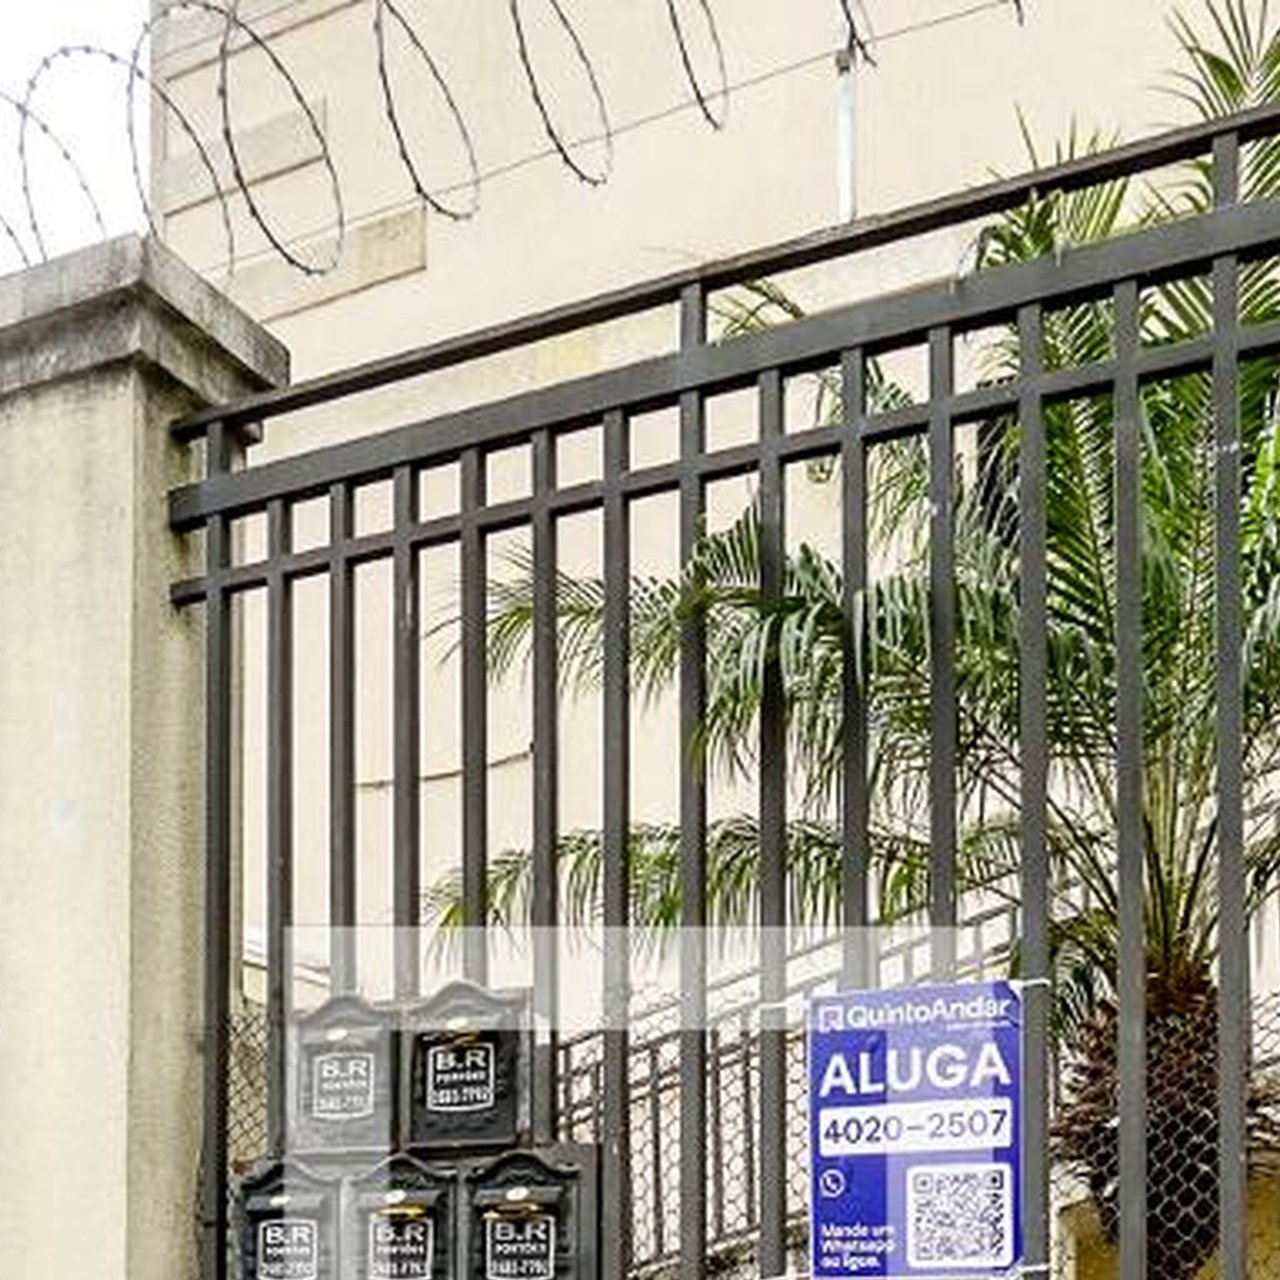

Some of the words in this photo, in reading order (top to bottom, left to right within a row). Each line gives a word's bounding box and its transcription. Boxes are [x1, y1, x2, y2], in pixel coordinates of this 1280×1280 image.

[847, 997, 1011, 1028] QuintoAndar
[819, 1043, 1011, 1097] ALUGA
[824, 1109, 1007, 1145] 4020-2507
